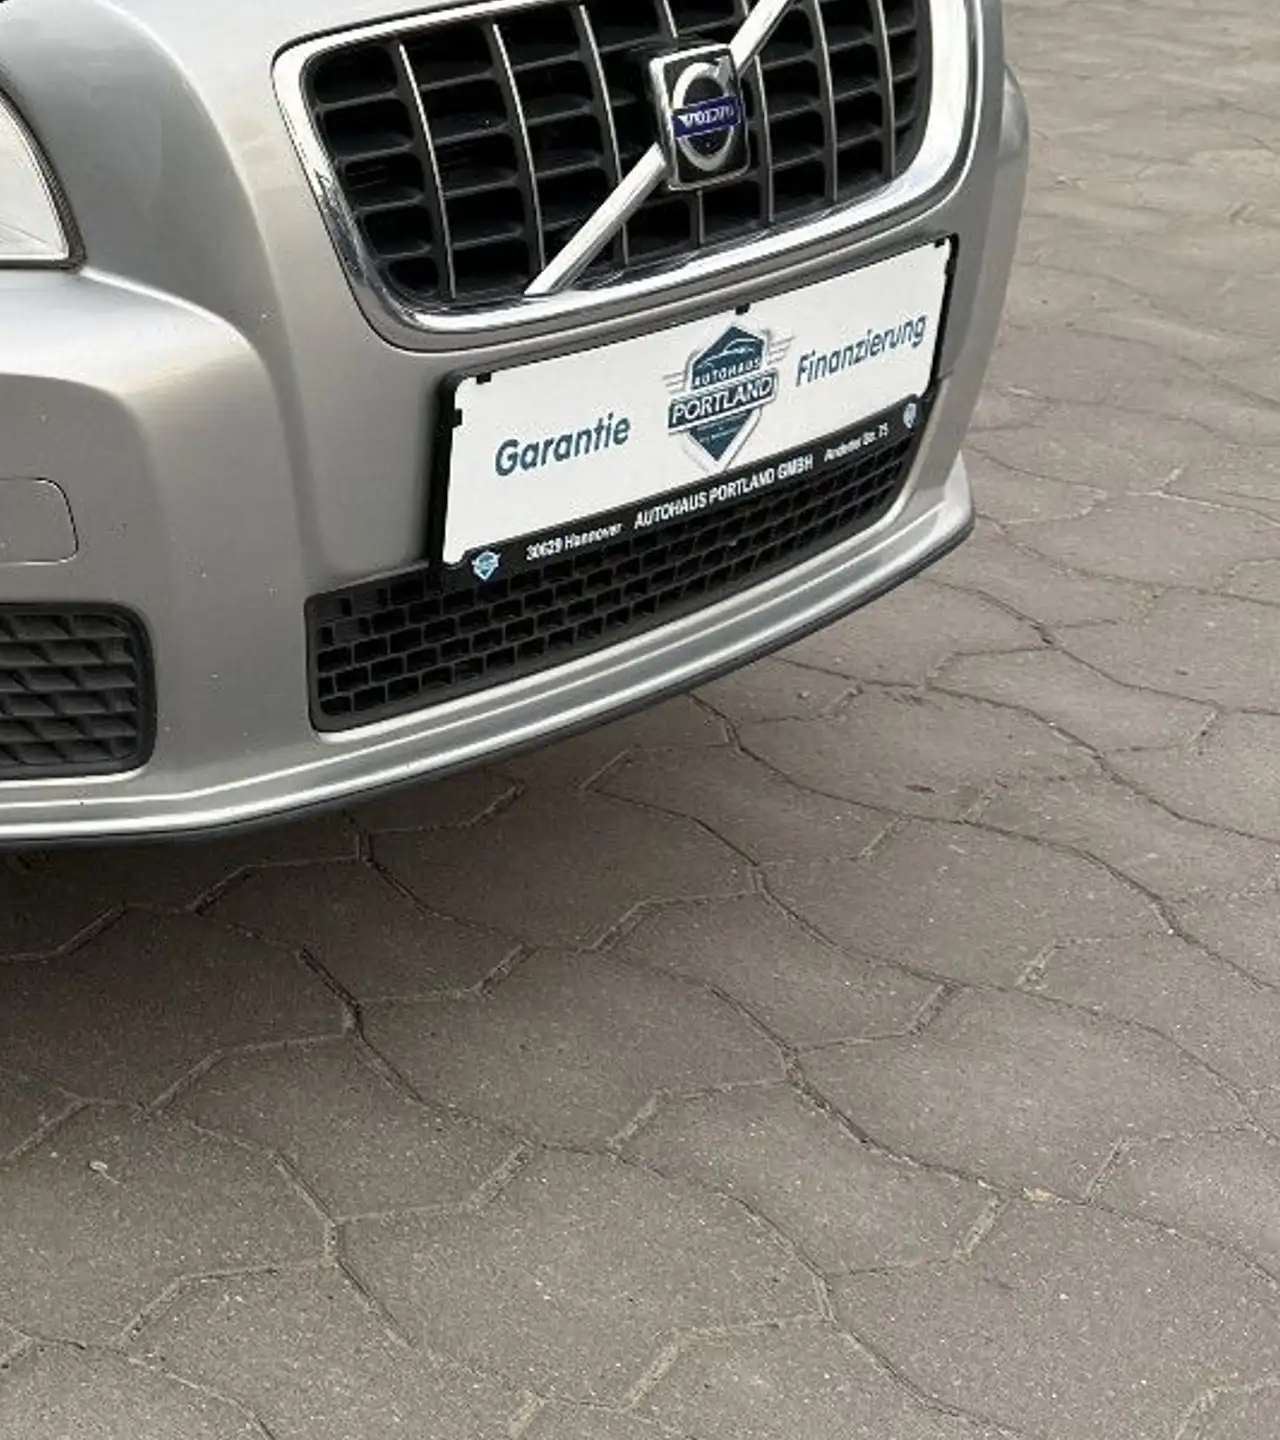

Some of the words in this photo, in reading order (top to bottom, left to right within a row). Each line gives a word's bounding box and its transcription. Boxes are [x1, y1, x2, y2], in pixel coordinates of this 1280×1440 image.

[494, 411, 631, 477] Garantie
[795, 314, 927, 387] Finanzierung
[672, 375, 774, 425] PORTLAND
[694, 358, 760, 387] AUTOHAUS
[564, 522, 623, 550] Hannover
[634, 491, 707, 530] AUTOHAUS
[708, 469, 775, 506] PORTLAND
[777, 453, 814, 483] GMBH
